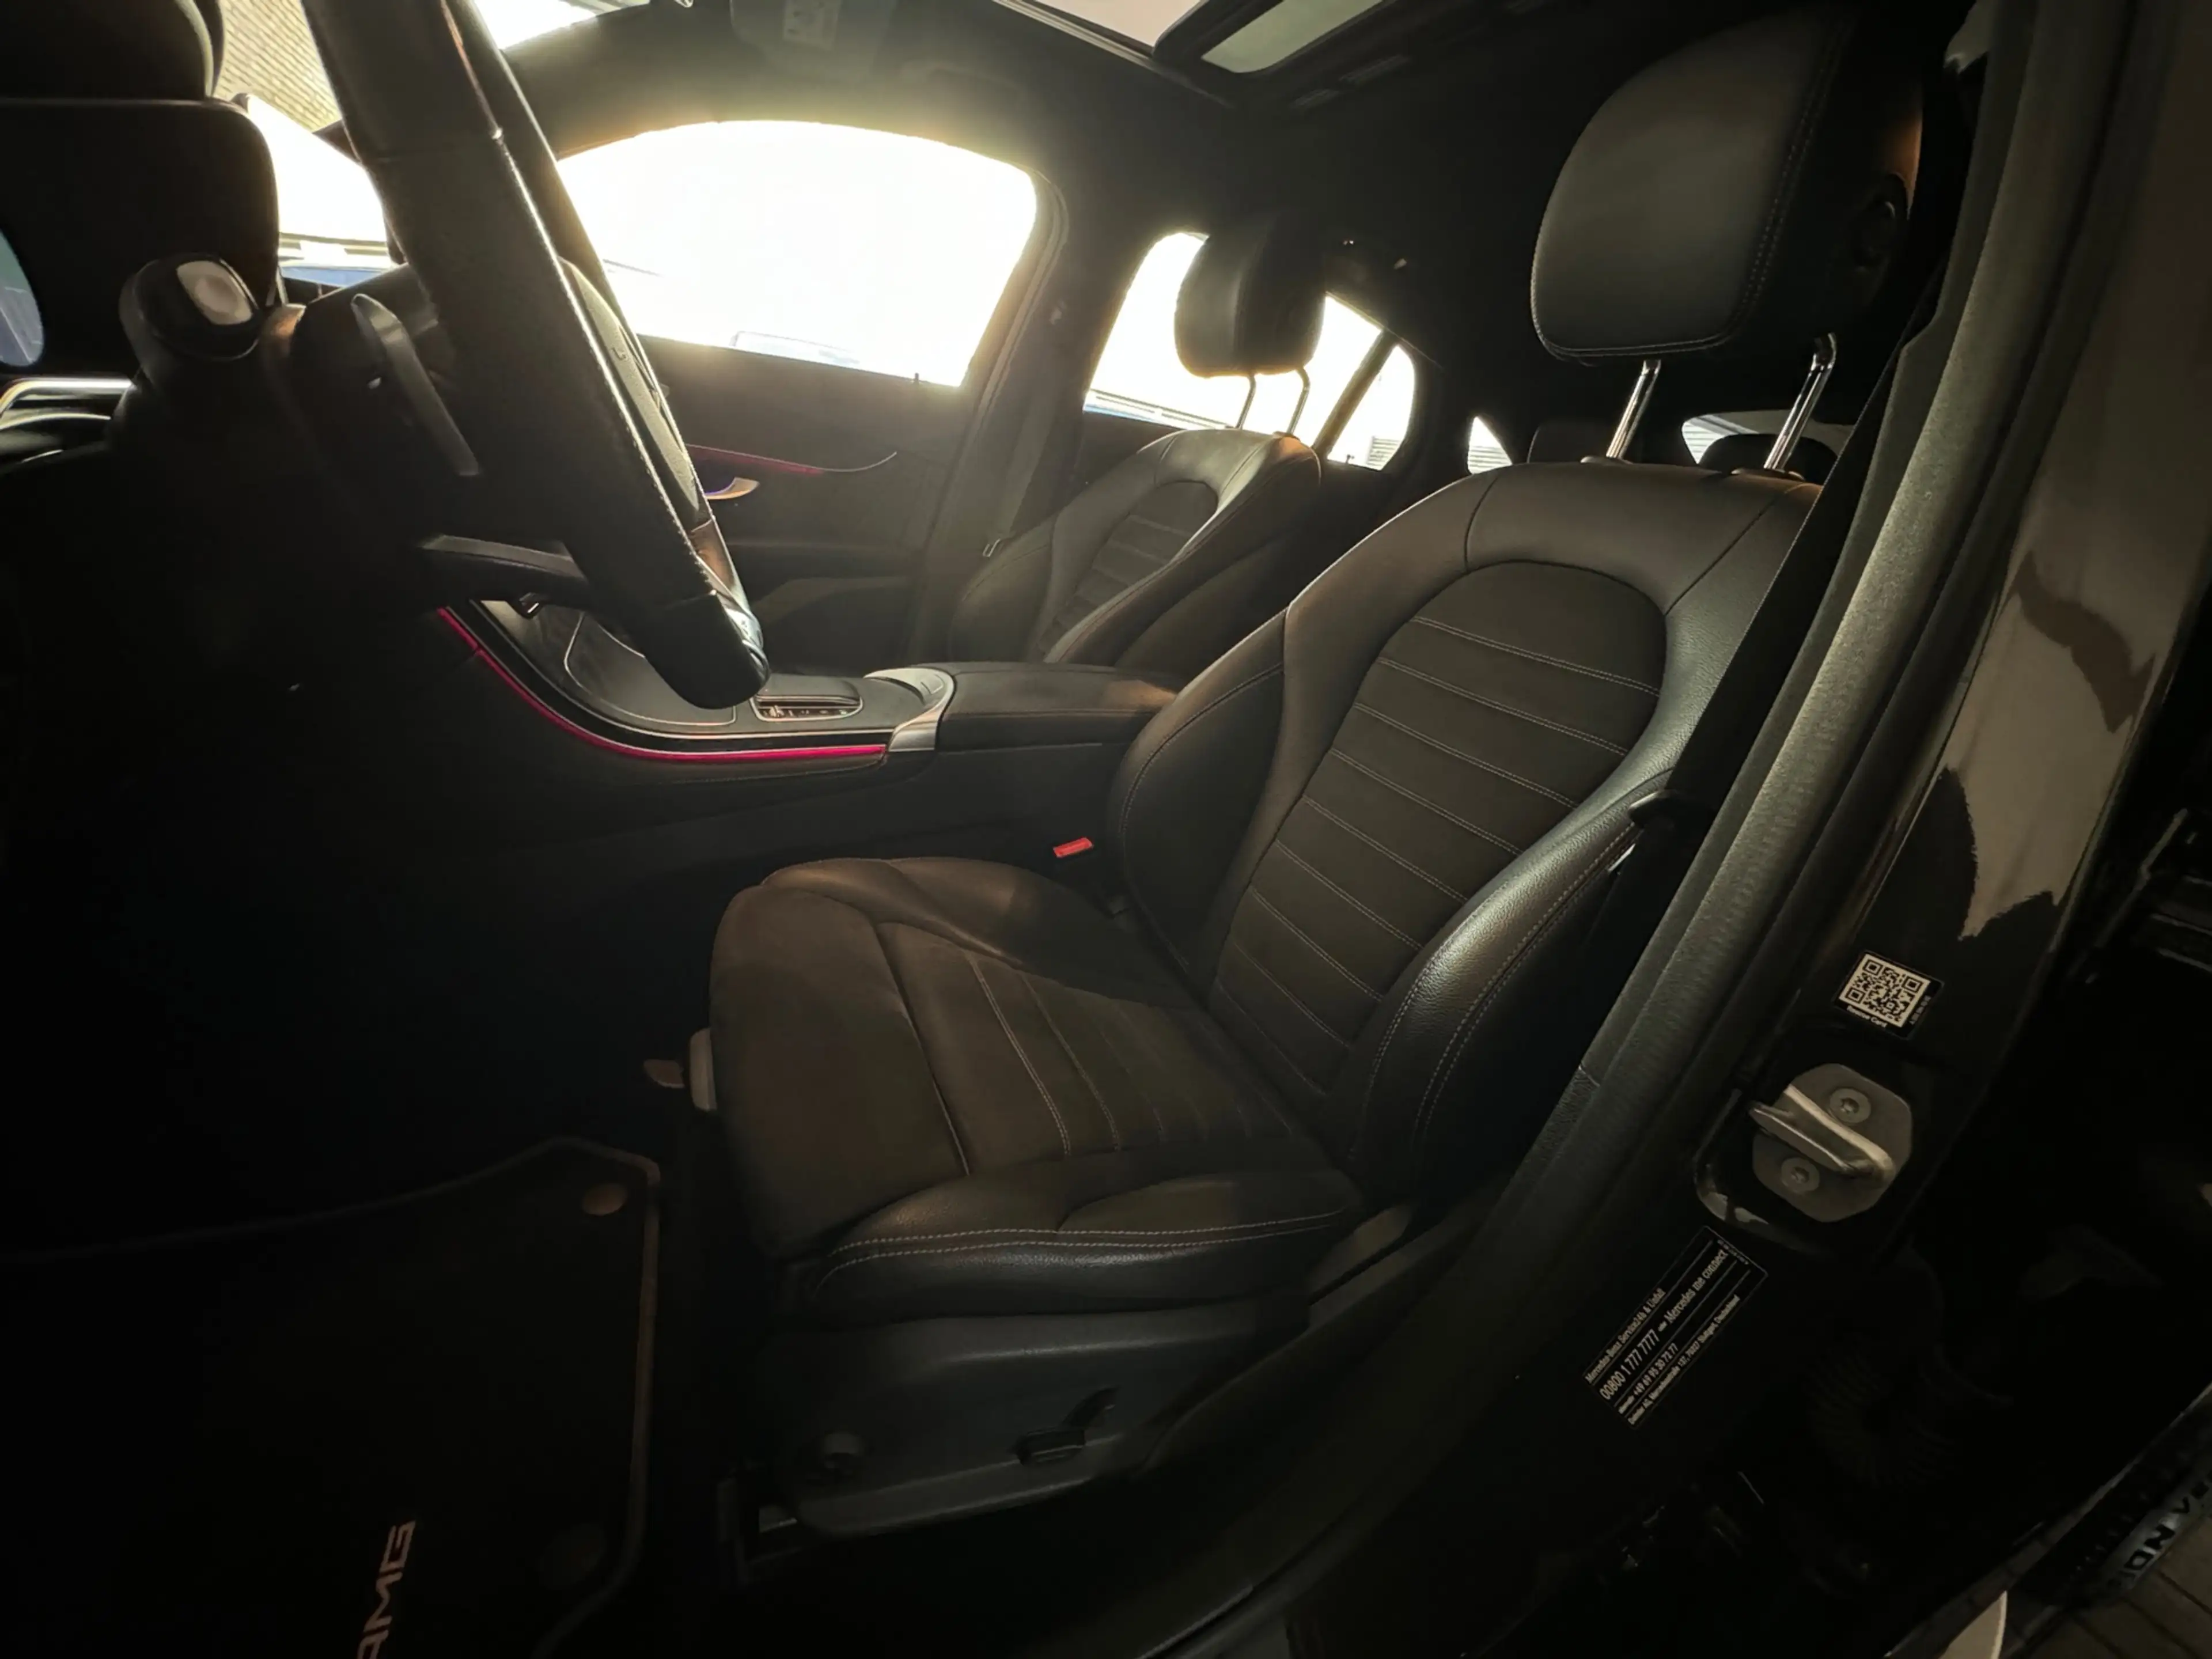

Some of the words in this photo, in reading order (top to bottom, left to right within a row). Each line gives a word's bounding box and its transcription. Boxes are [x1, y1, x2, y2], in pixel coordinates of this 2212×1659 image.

[1702, 1249, 1729, 1279] connect
[1692, 1277, 1706, 1291] me
[1664, 1288, 1696, 1324] Mercedes
[1637, 1328, 1660, 1355] 7777
[1668, 1343, 1679, 1355] 77
[1620, 1365, 1631, 1375] 1
[1624, 1349, 1642, 1370] 777
[1599, 1370, 1626, 1400] 00800
